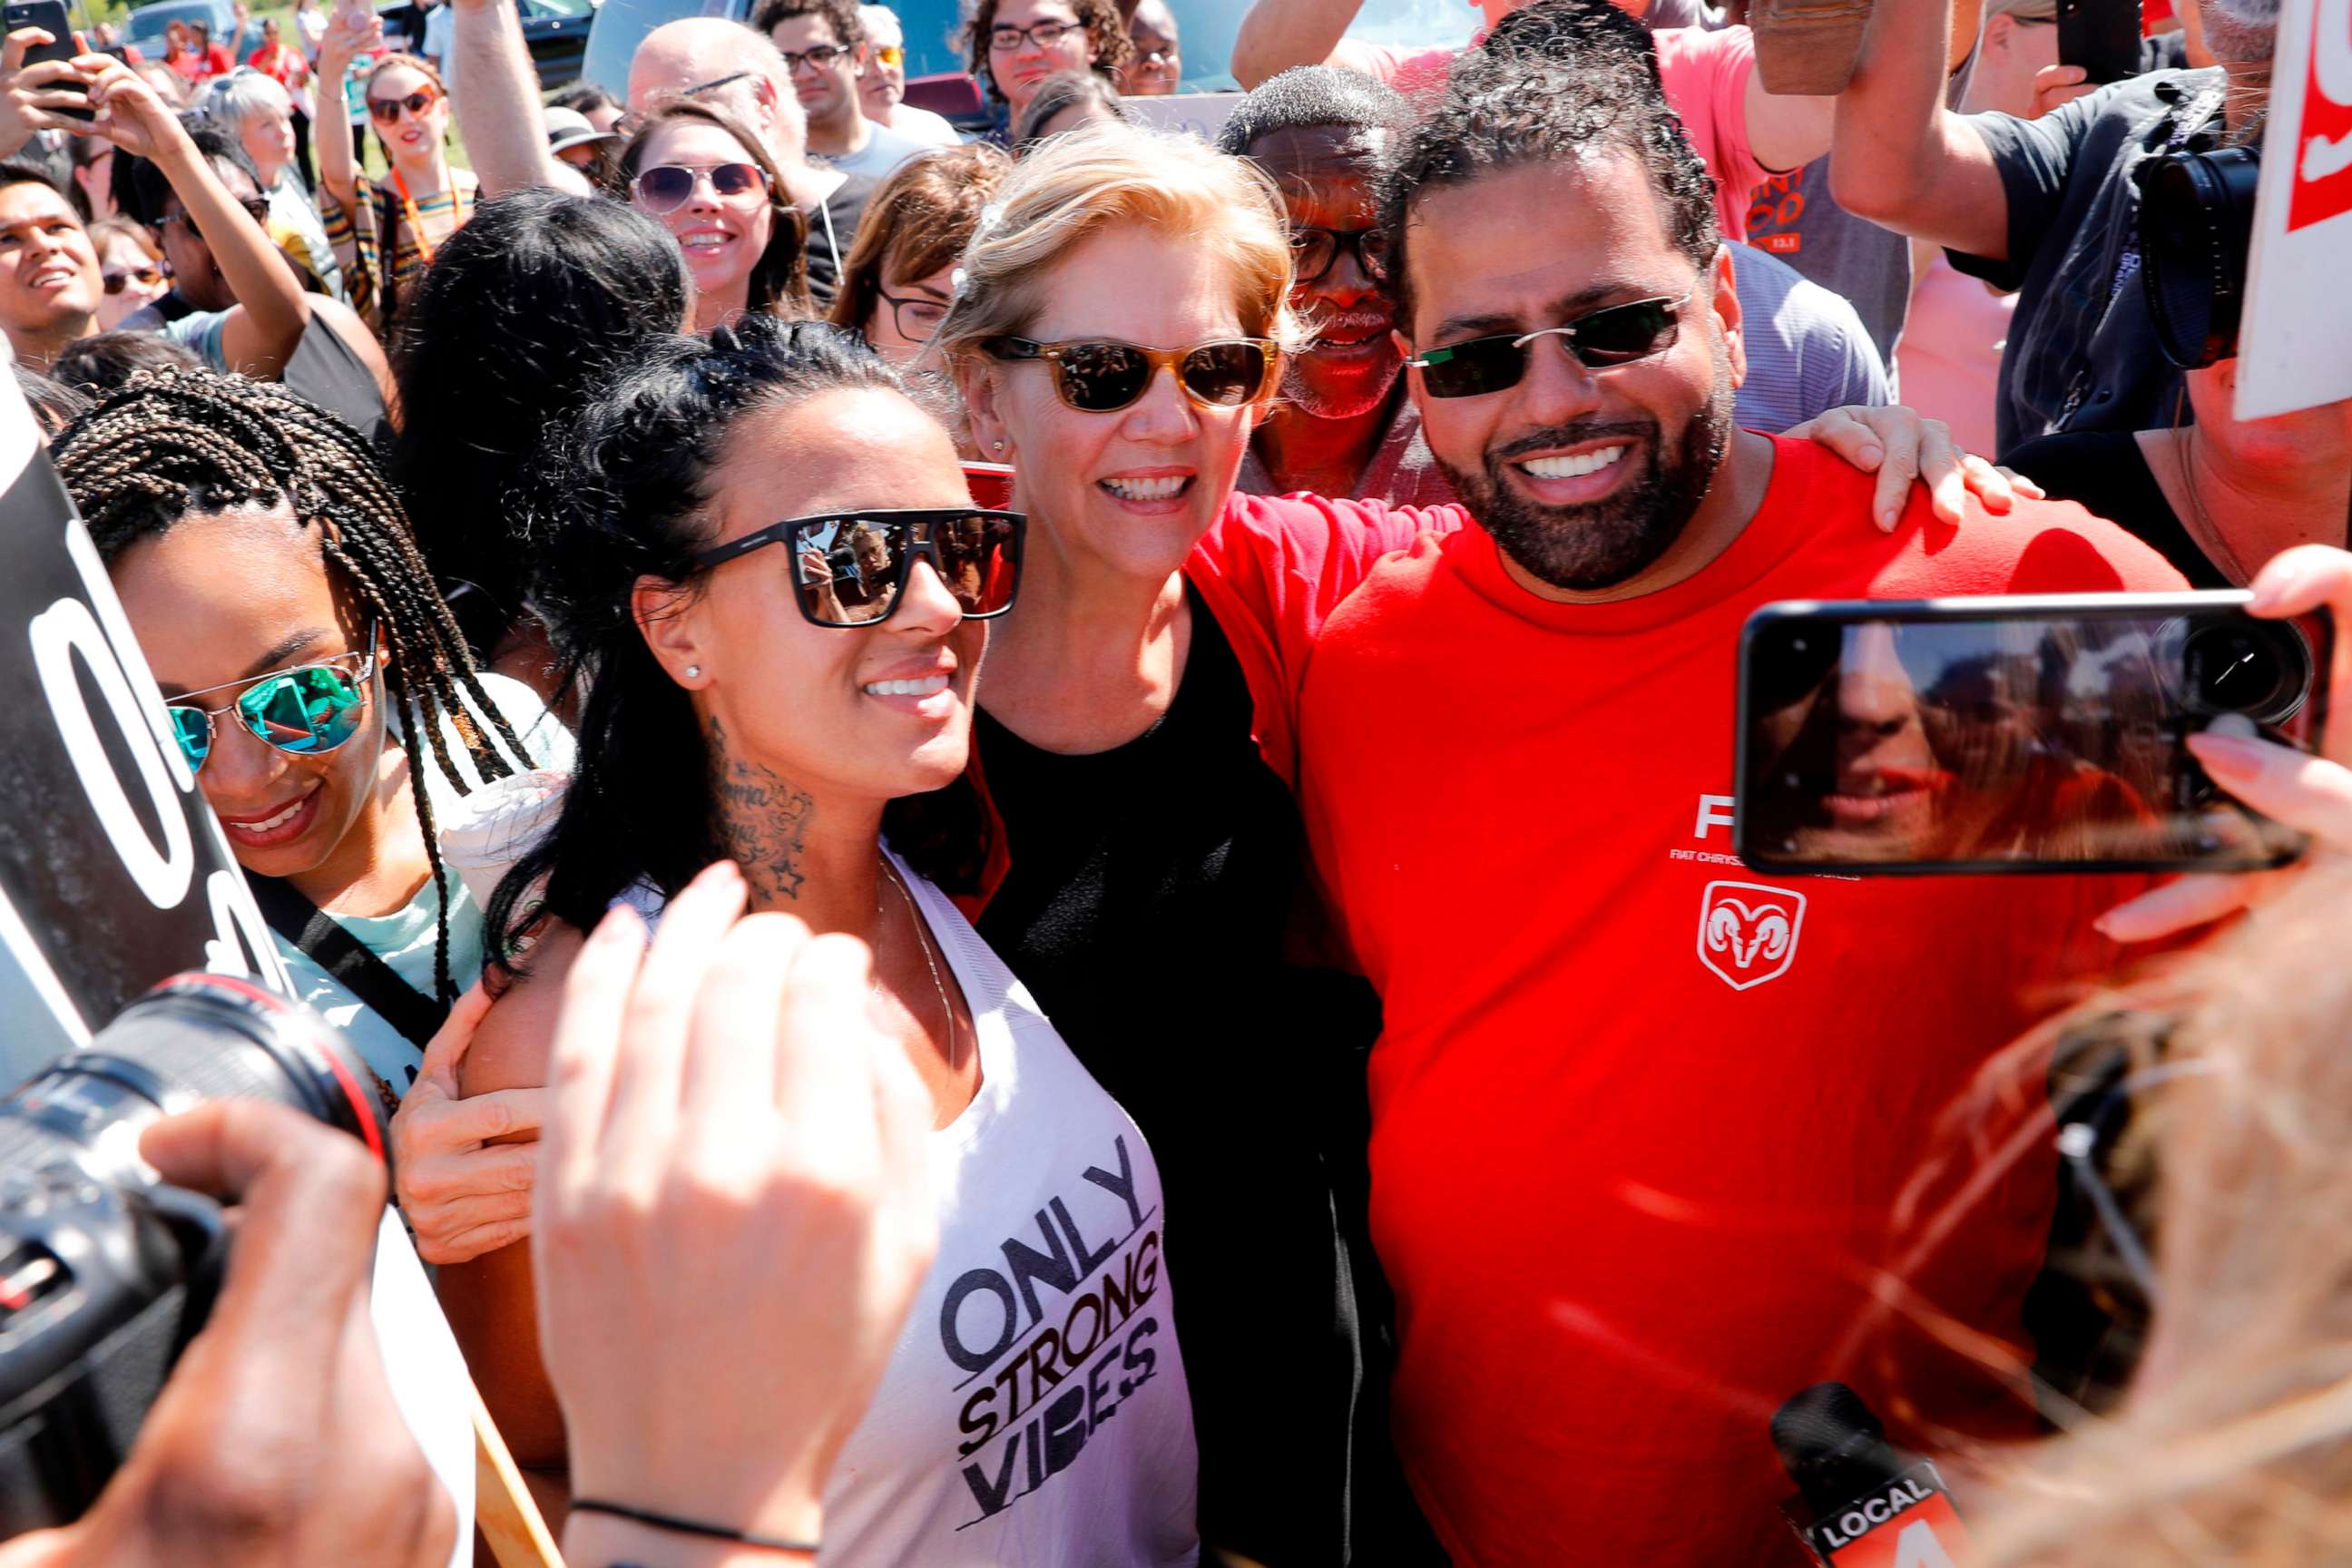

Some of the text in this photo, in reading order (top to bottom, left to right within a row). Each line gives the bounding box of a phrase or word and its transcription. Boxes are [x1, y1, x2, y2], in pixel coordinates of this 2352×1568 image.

[1670, 848, 1747, 867] FIAT CHRYS
[940, 1134, 1145, 1372] ONLY
[958, 1230, 1158, 1456] STRONG
[962, 1317, 1158, 1518] VIBES
[1822, 1478, 1934, 1548] LOCAL
